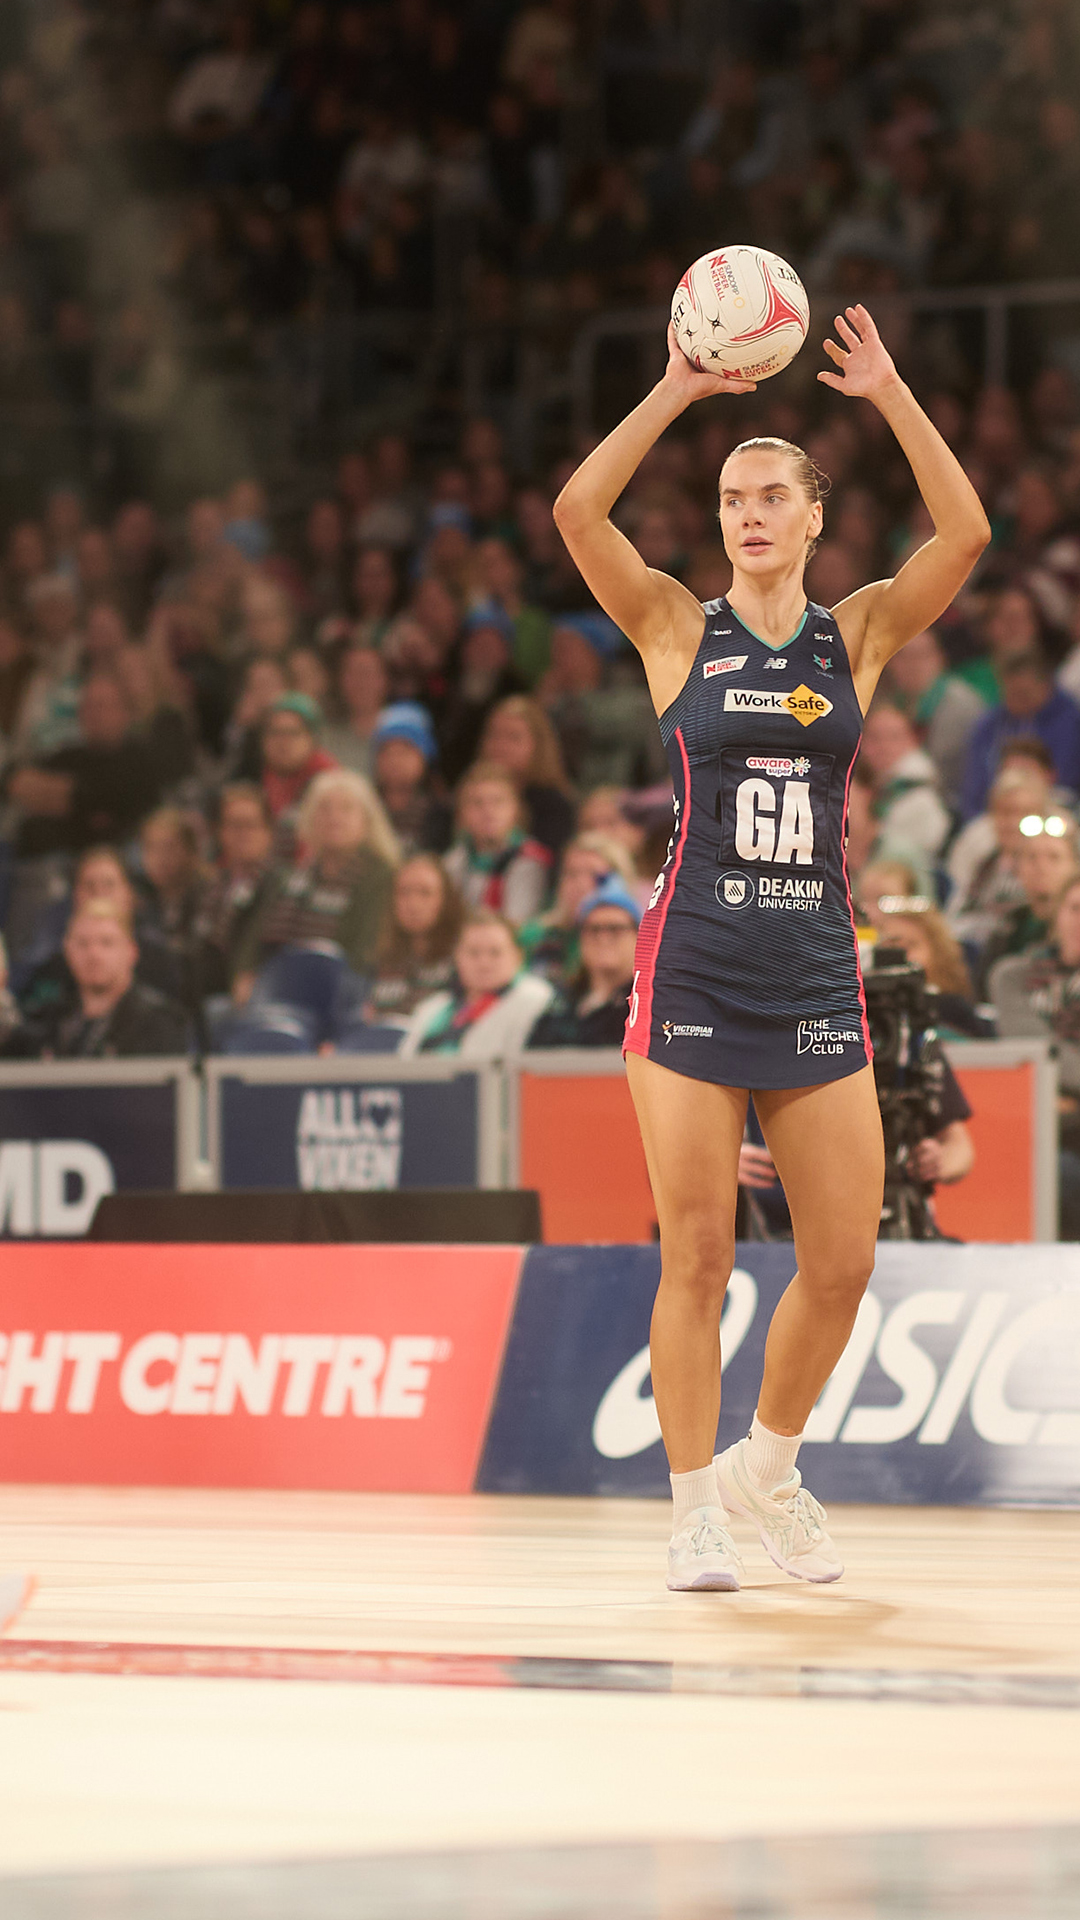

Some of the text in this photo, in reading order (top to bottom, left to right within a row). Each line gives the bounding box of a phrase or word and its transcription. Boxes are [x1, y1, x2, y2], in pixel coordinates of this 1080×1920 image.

[710, 269, 726, 302] NETBALL
[717, 266, 730, 290] SUPER
[734, 693, 825, 711] Work Safe
[748, 758, 792, 769] aware
[768, 767, 791, 776] super
[735, 777, 814, 865] GA
[759, 877, 824, 899] DEAKIN
[757, 897, 822, 911] UNIVERSITY
[672, 1024, 714, 1034] VICTORIAN
[808, 1019, 830, 1030] THE
[812, 1043, 844, 1055] CLUB
[0, 1331, 436, 1419] HT CENTRE
